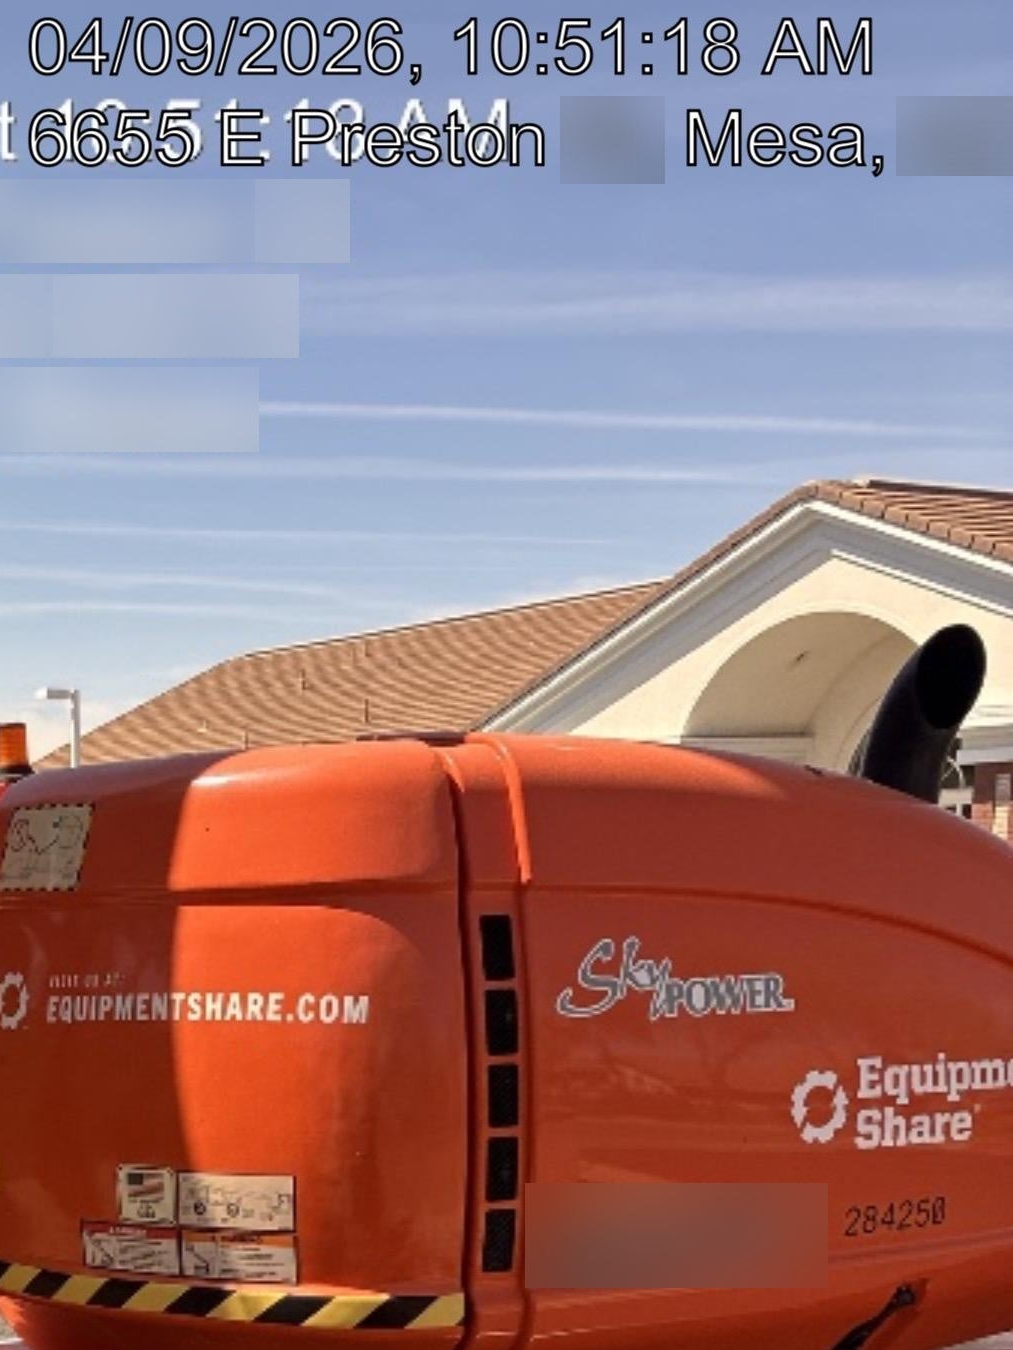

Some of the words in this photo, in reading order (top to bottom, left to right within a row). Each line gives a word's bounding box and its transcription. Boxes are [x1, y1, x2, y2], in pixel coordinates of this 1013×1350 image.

[46, 992, 370, 1025] EQUIPMENTSHARE.COM
[854, 1106, 973, 1150] Share
[844, 1196, 946, 1237] 284250
